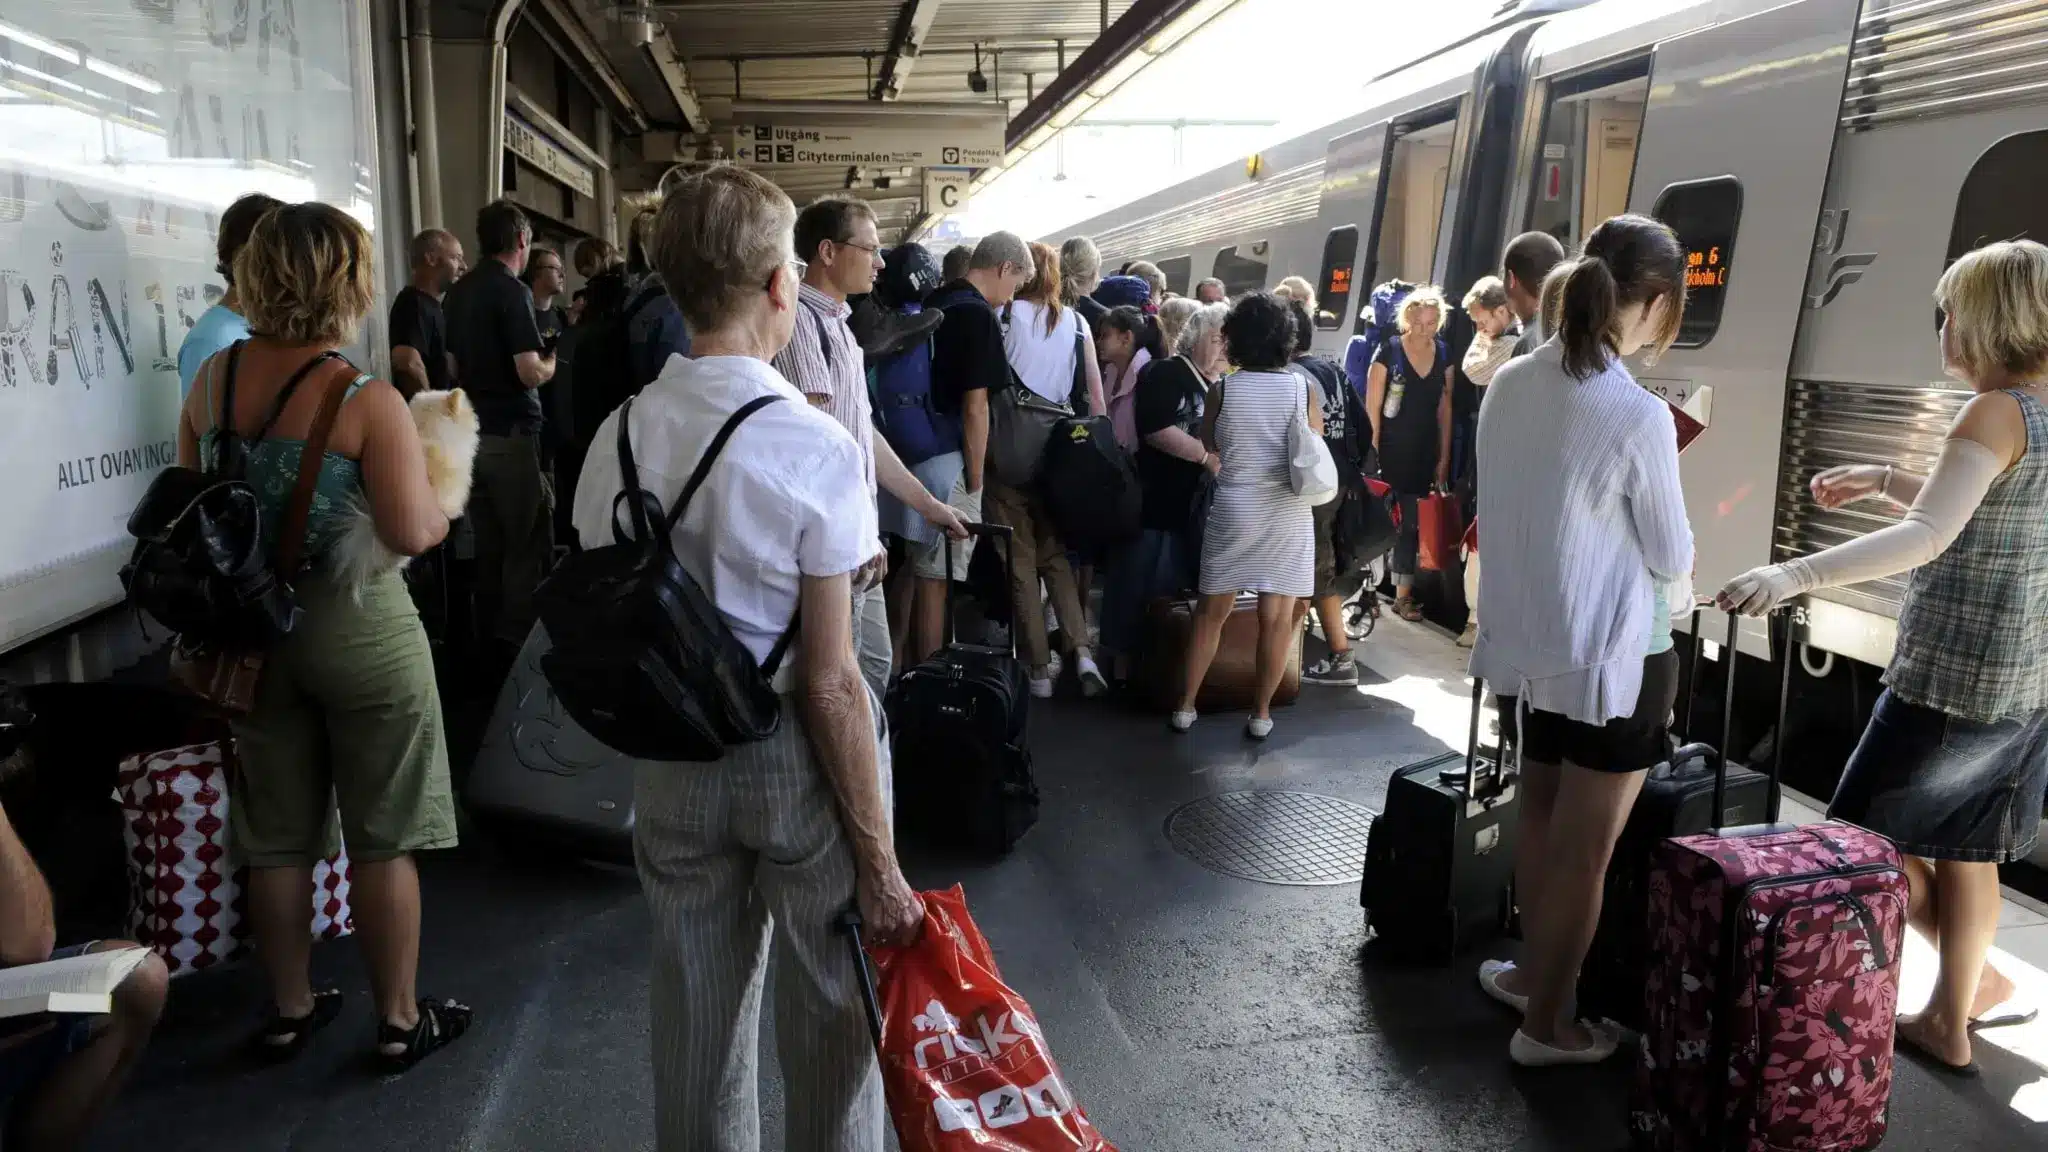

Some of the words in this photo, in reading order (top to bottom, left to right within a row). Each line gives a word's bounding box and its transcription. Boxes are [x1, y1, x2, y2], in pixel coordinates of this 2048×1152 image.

[776, 128, 820, 143] Utgång
[797, 150, 890, 164] Cityterminalen
[940, 184, 958, 208] C
[1708, 246, 1718, 265] 6
[57, 455, 97, 492] ALLT
[100, 447, 142, 480] OVAN
[144, 432, 177, 469] INGÅ
